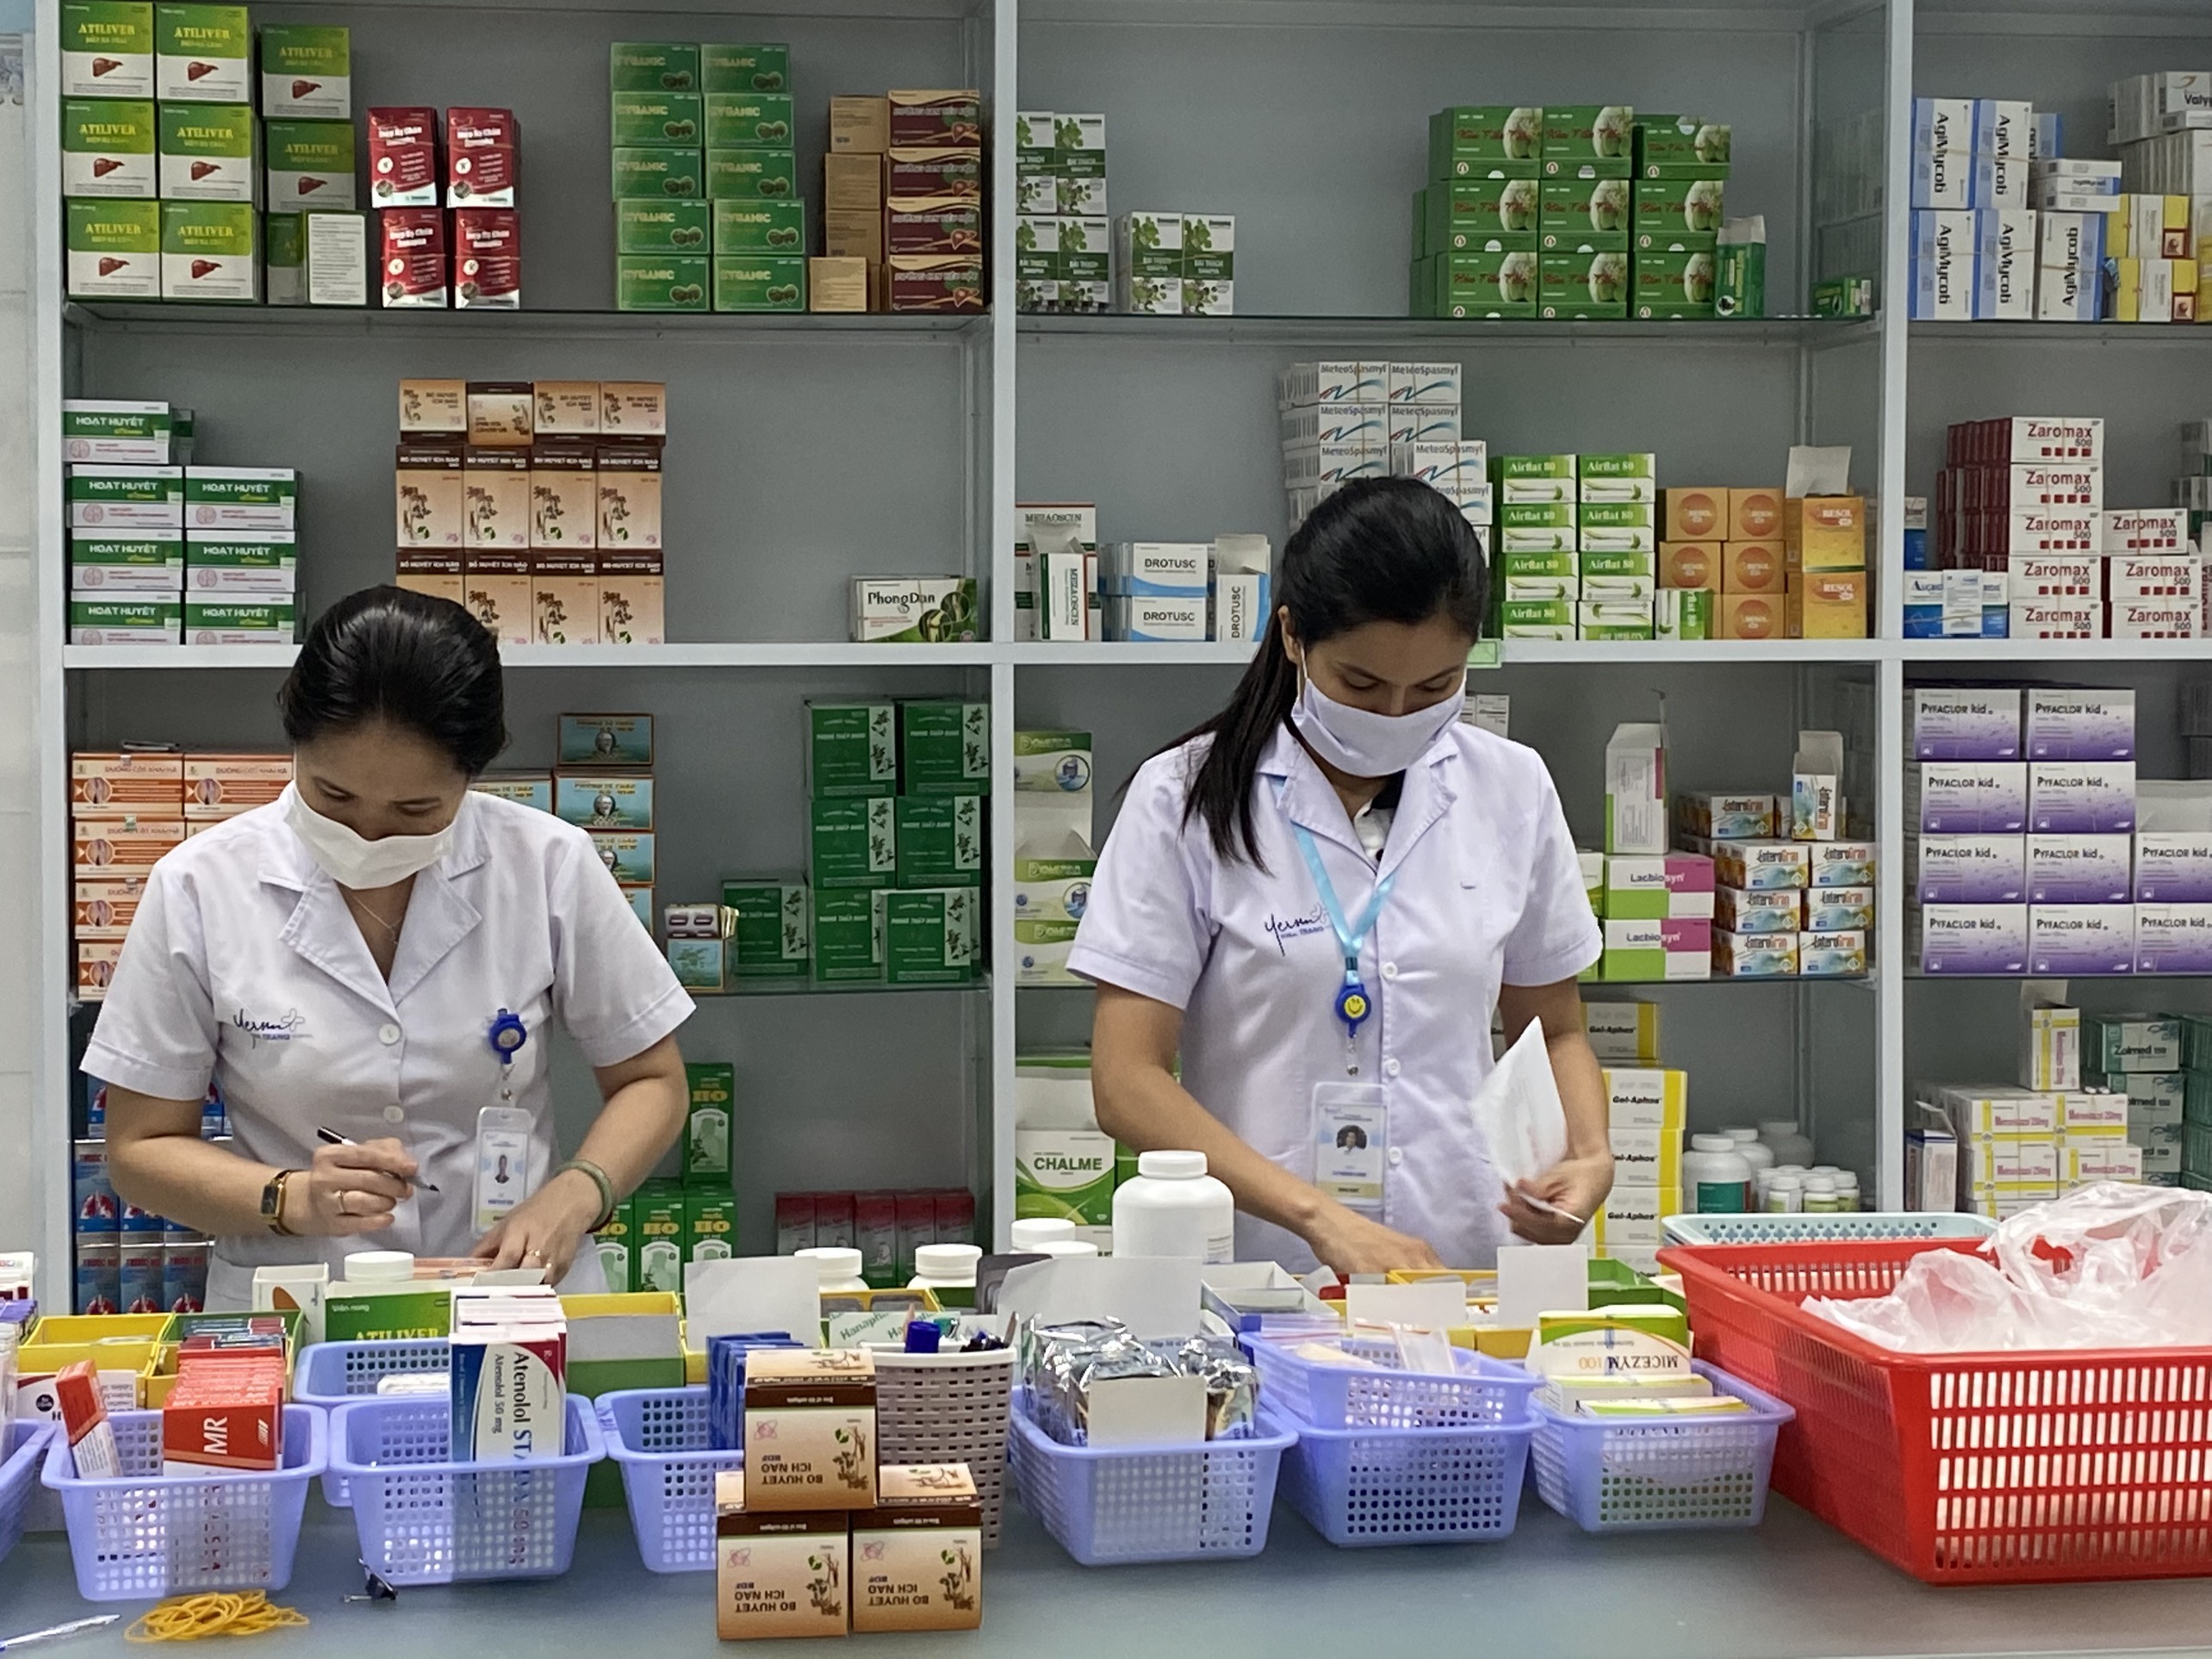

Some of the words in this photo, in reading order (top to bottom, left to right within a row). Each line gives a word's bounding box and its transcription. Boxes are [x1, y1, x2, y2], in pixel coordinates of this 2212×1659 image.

[78, 23, 135, 35] ATILIVER
[174, 27, 230, 40] ATILIVER
[80, 124, 136, 135] ATILIVER
[177, 127, 233, 139] ATILIVER
[1934, 112, 1948, 193] AgiMycob
[1995, 115, 2010, 196] AgiMycob
[1936, 224, 1953, 305] AgiMycob
[1998, 223, 2014, 304] AgiMycob
[2061, 227, 2078, 307] AgiMycob
[1320, 364, 1386, 375] MeteoSpasmyl
[1392, 365, 1457, 376] MeteoSpasmyl
[1320, 406, 1386, 416] MeteoSpasmyl
[1392, 407, 1457, 417] MeteoSpasmyl
[2028, 424, 2092, 438] Zaromax
[2075, 438, 2092, 447] 500
[1322, 446, 1387, 457] MeteoSpasmyl
[1416, 444, 1483, 455] MeteoSpasmyl
[1509, 462, 1541, 473] Airflat
[1587, 461, 1620, 471] Airflat
[2026, 471, 2091, 485] Zaromax
[2074, 485, 2091, 494] 500
[1508, 510, 1541, 521] Airflat
[1587, 511, 1619, 521] Airflat
[2026, 518, 2091, 531] Zaromax
[2113, 518, 2176, 530] Zaromax
[2159, 529, 2177, 537] 500
[1145, 559, 1196, 569] DROTUSC
[1513, 560, 1545, 570] Airflat
[1589, 559, 1623, 570] Airflat
[2024, 563, 2090, 577] Zaromax
[2126, 564, 2190, 577] Zaromax
[1143, 612, 1196, 622] DROTUSC
[1232, 586, 1240, 638] DROTUSC
[1509, 608, 1542, 619] Airflat
[2026, 609, 2091, 622] Zaromax
[2128, 609, 2191, 622] Zaromax
[1631, 872, 1685, 885] Lacbiosyn
[1626, 932, 1681, 943] Lacbiosyn
[1035, 1158, 1103, 1171] CHALME
[494, 1353, 505, 1398] Atenolol
[513, 1351, 531, 1423] Atenolol
[204, 1417, 227, 1454] MR
[514, 1430, 531, 1459] ST
[761, 1463, 787, 1473] NAO
[792, 1463, 811, 1473] ICH
[761, 1475, 803, 1485] HUYET
[867, 1584, 894, 1594] NAO
[898, 1583, 917, 1593] ICH
[735, 1591, 761, 1600] NAO
[764, 1590, 784, 1599] ICH
[867, 1596, 910, 1606] HUYET
[735, 1602, 776, 1612] HUYET
